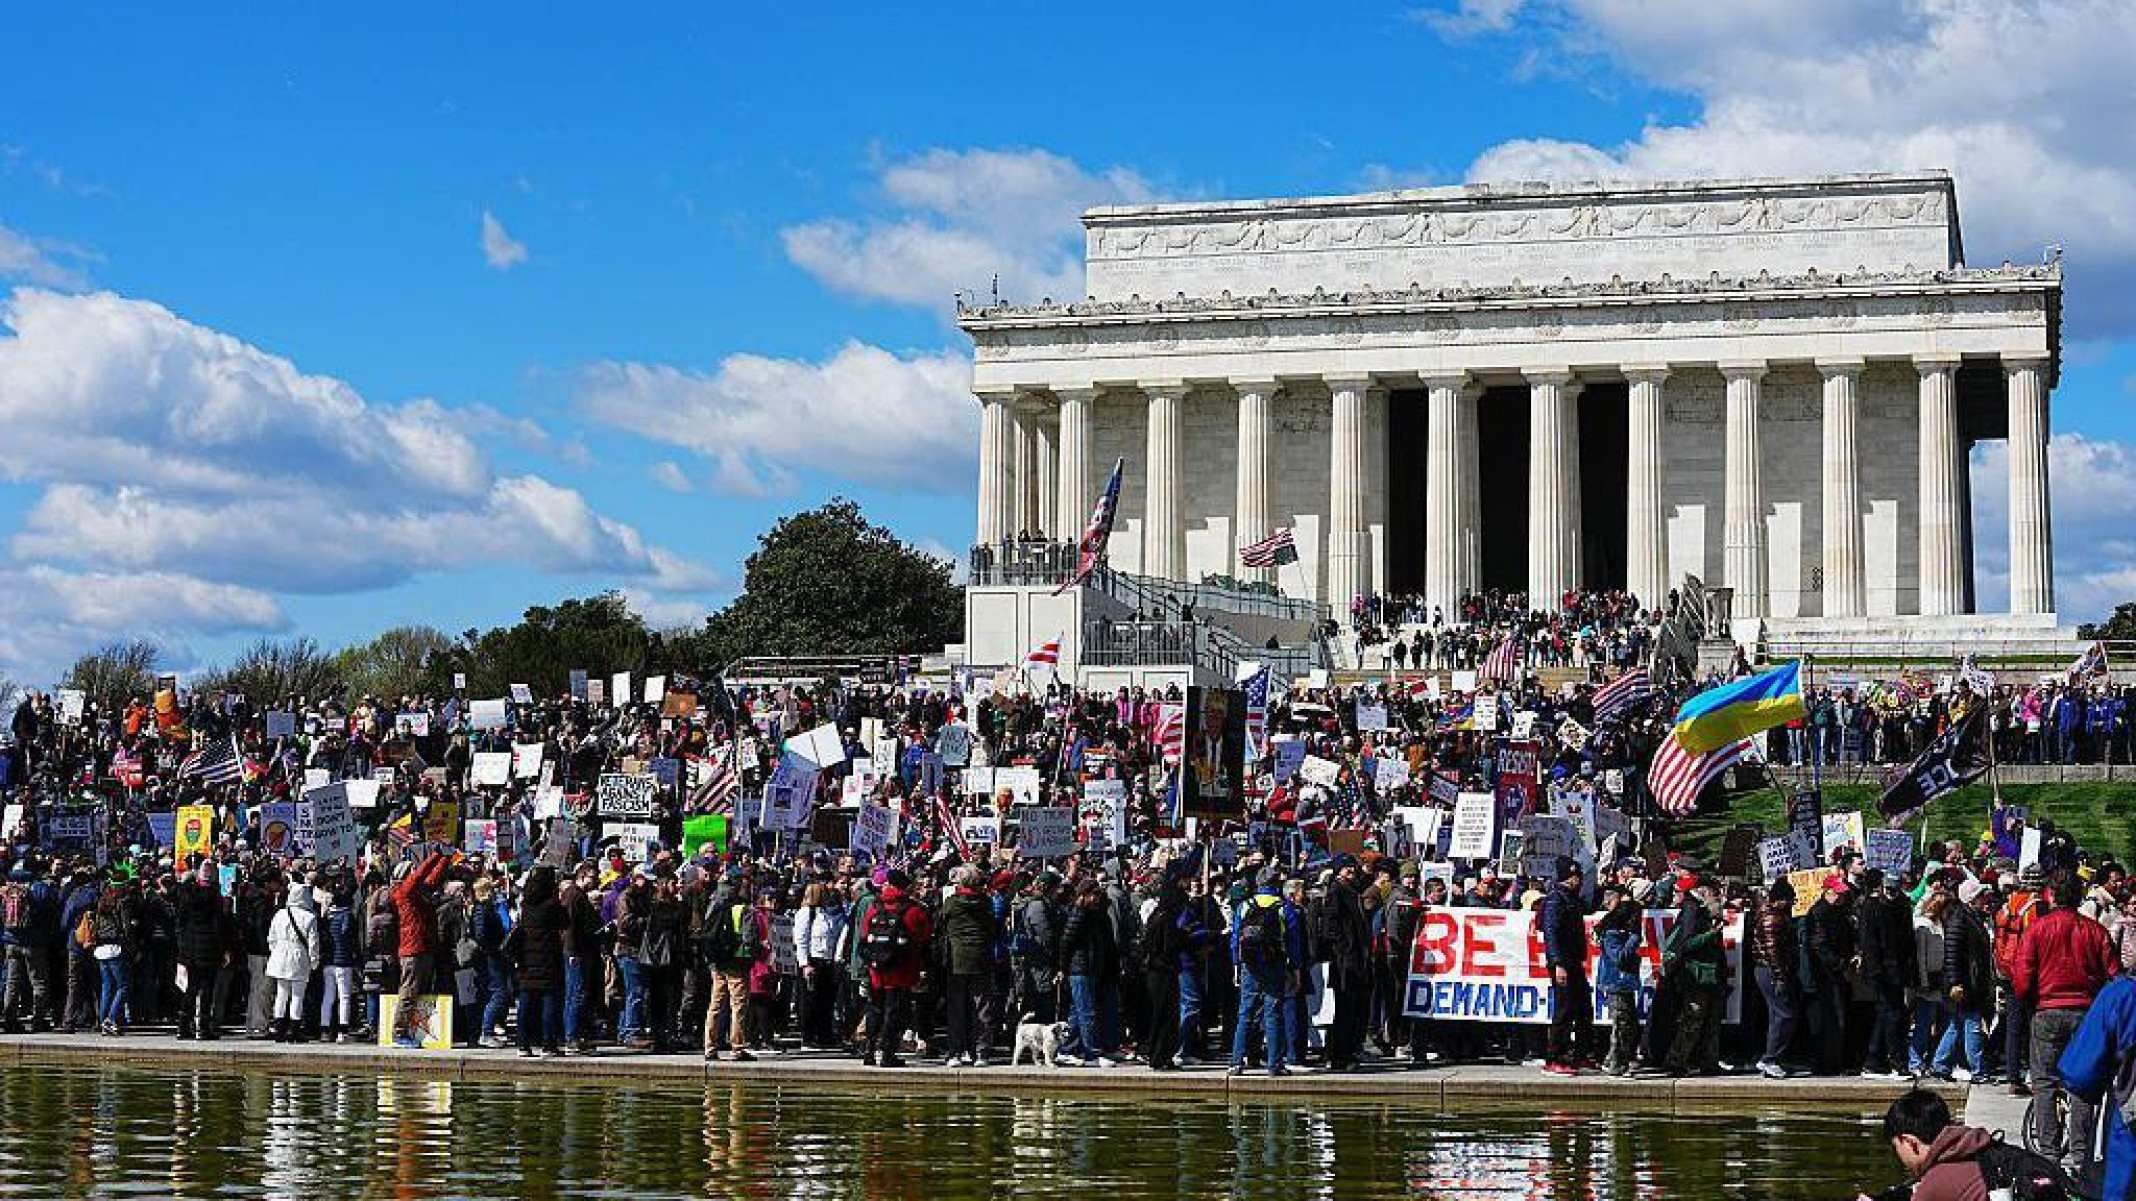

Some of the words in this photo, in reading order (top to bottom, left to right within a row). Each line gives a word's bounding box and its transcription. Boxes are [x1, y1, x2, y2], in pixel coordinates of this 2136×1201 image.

[602, 786, 647, 800] AGAINST
[602, 798, 650, 811] FASCISM
[1411, 912, 1507, 977] BE
